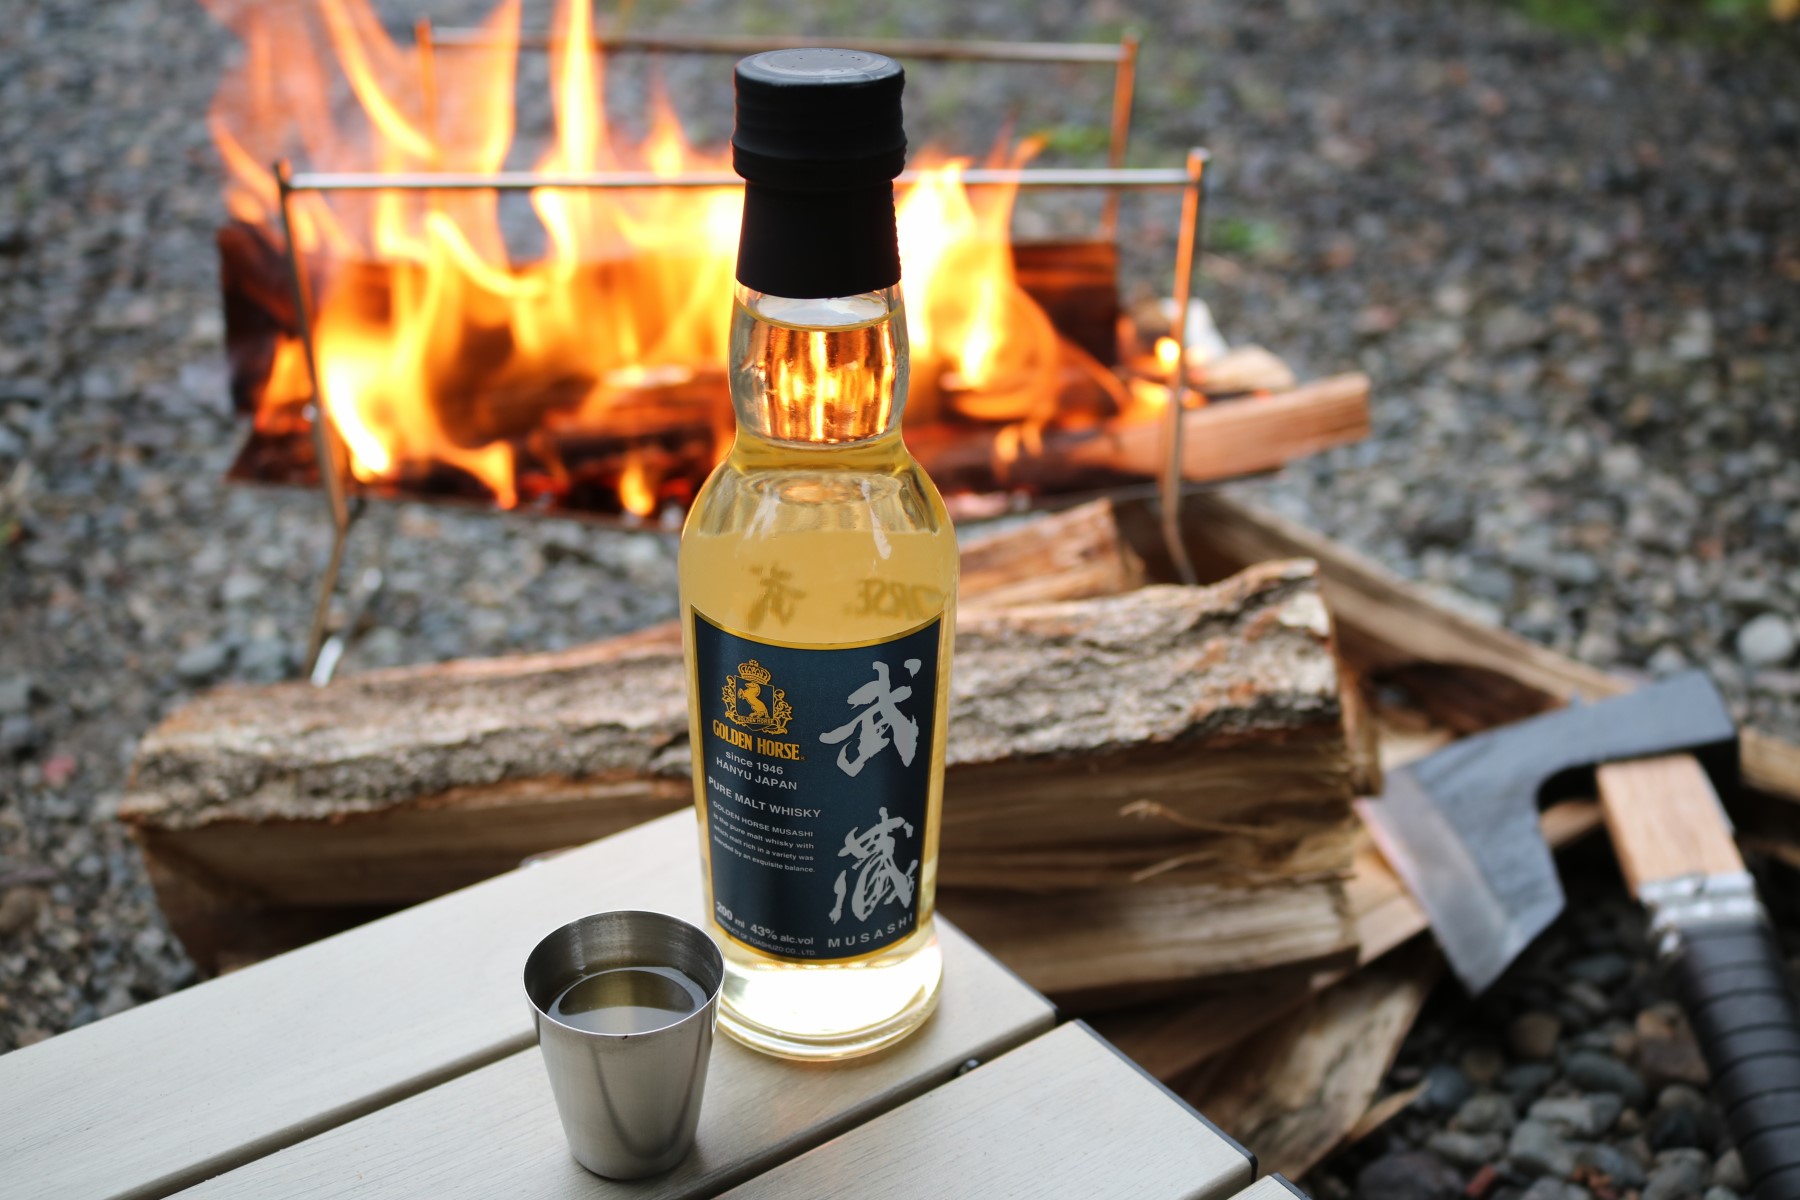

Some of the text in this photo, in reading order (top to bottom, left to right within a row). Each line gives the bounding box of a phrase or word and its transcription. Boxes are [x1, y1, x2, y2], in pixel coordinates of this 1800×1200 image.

[712, 719, 800, 760] GOLDEN HORSE
[716, 757, 797, 790] HANYU JAPAN
[725, 751, 783, 775] since 1946
[708, 776, 821, 818] PURE MALT WHISKY
[713, 800, 814, 837] GOLDEN HORSE MUSASHI
[729, 823, 746, 835] pure
[747, 832, 763, 842] malt
[765, 836, 794, 849] whisky
[743, 841, 756, 851] rich
[757, 846, 765, 854] in
[772, 850, 797, 861] variety
[735, 847, 742, 858] by
[752, 857, 783, 870] exquisite
[784, 864, 815, 873] balance.
[716, 901, 814, 945] 200 ml 43% alc.vol
[828, 912, 912, 948] MUSASHI
